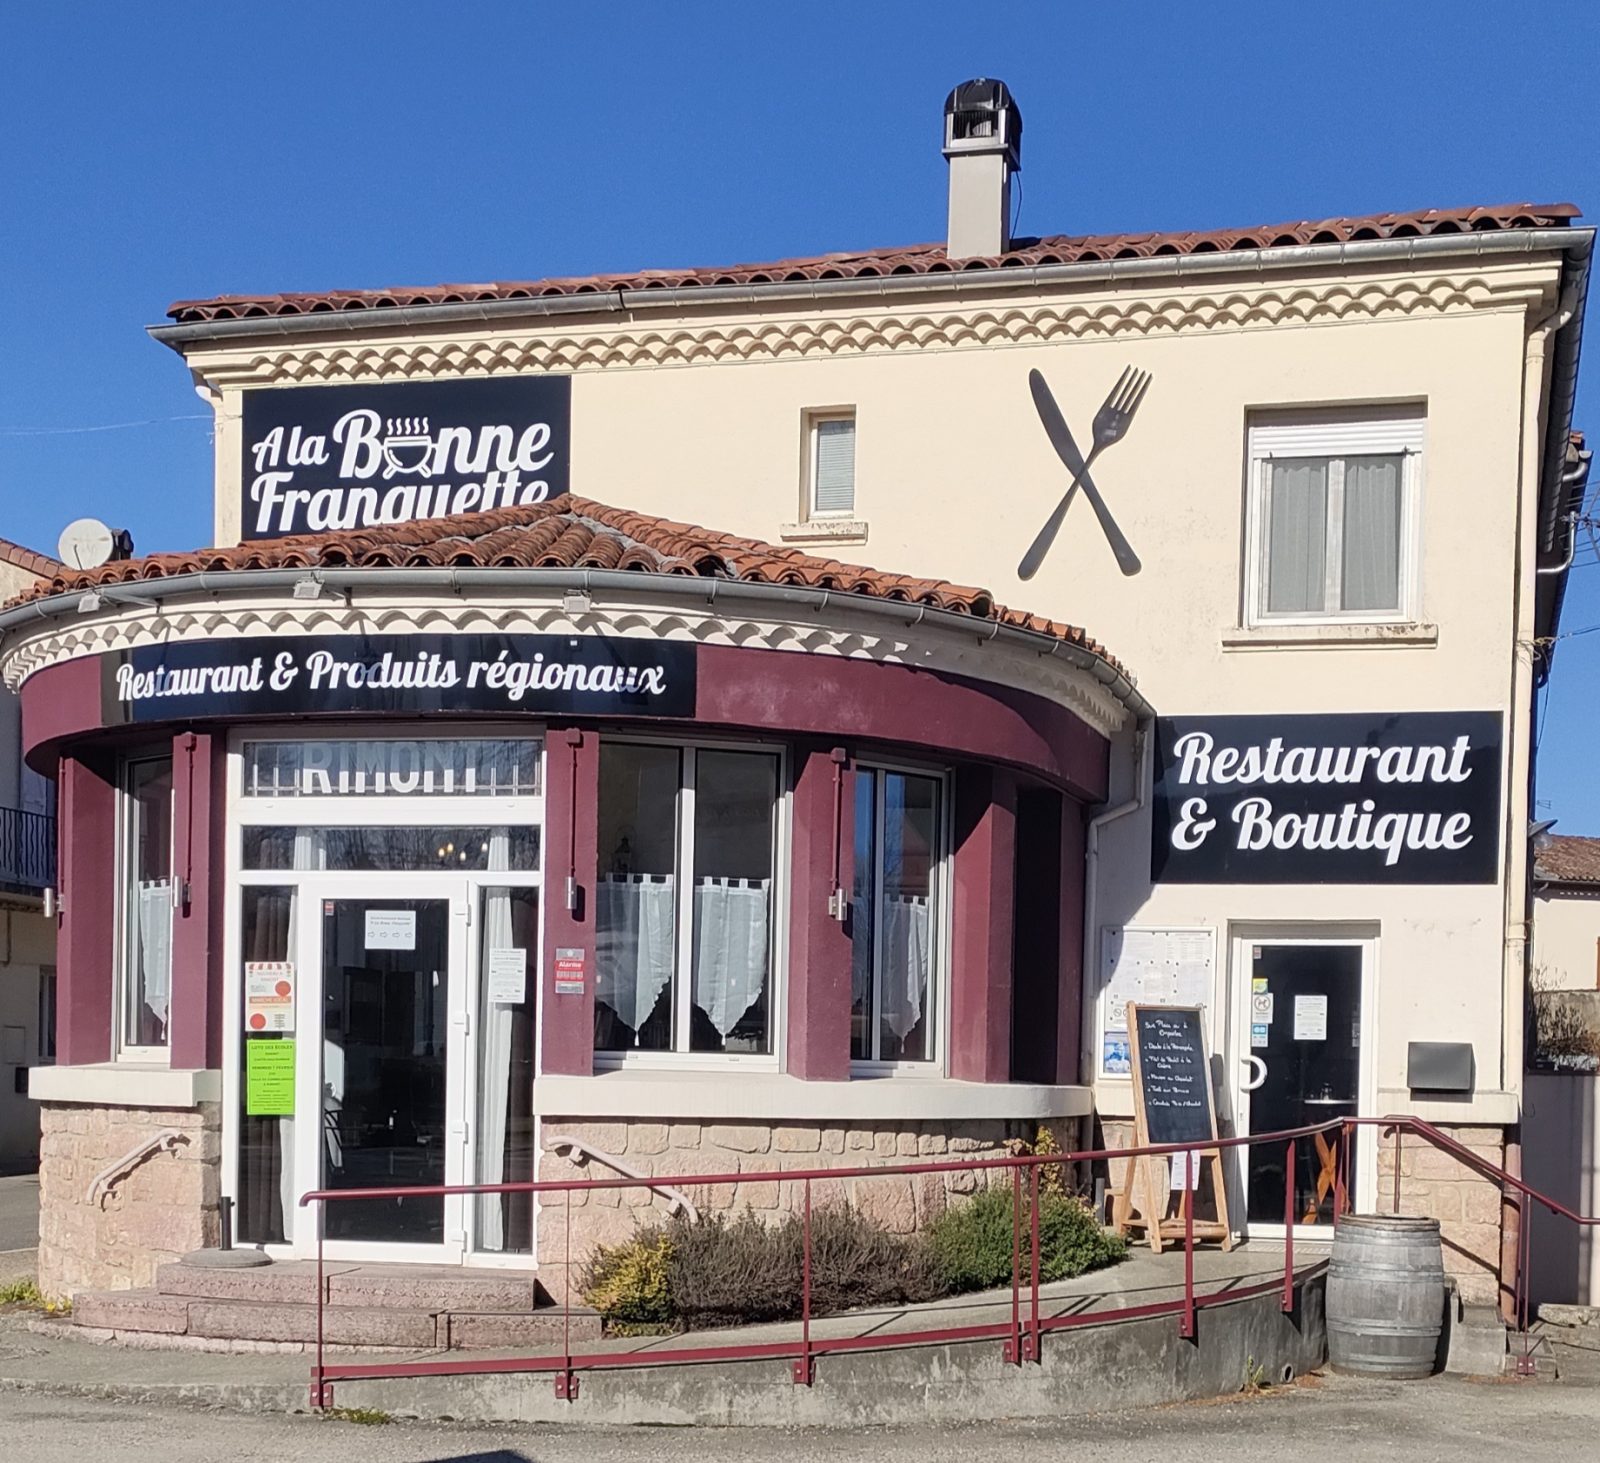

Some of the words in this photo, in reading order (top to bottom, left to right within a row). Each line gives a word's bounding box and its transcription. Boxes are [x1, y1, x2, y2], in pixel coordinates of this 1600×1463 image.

[252, 426, 284, 473] A
[287, 425, 330, 467] la
[250, 470, 550, 533] Franquette
[116, 656, 264, 701] Restaurant
[269, 651, 299, 692] &
[305, 650, 461, 691] Produits
[466, 651, 667, 701] régionaux
[1173, 731, 1473, 785] Restaurant
[1171, 797, 1217, 851] &
[1231, 797, 1474, 866] Boutique
